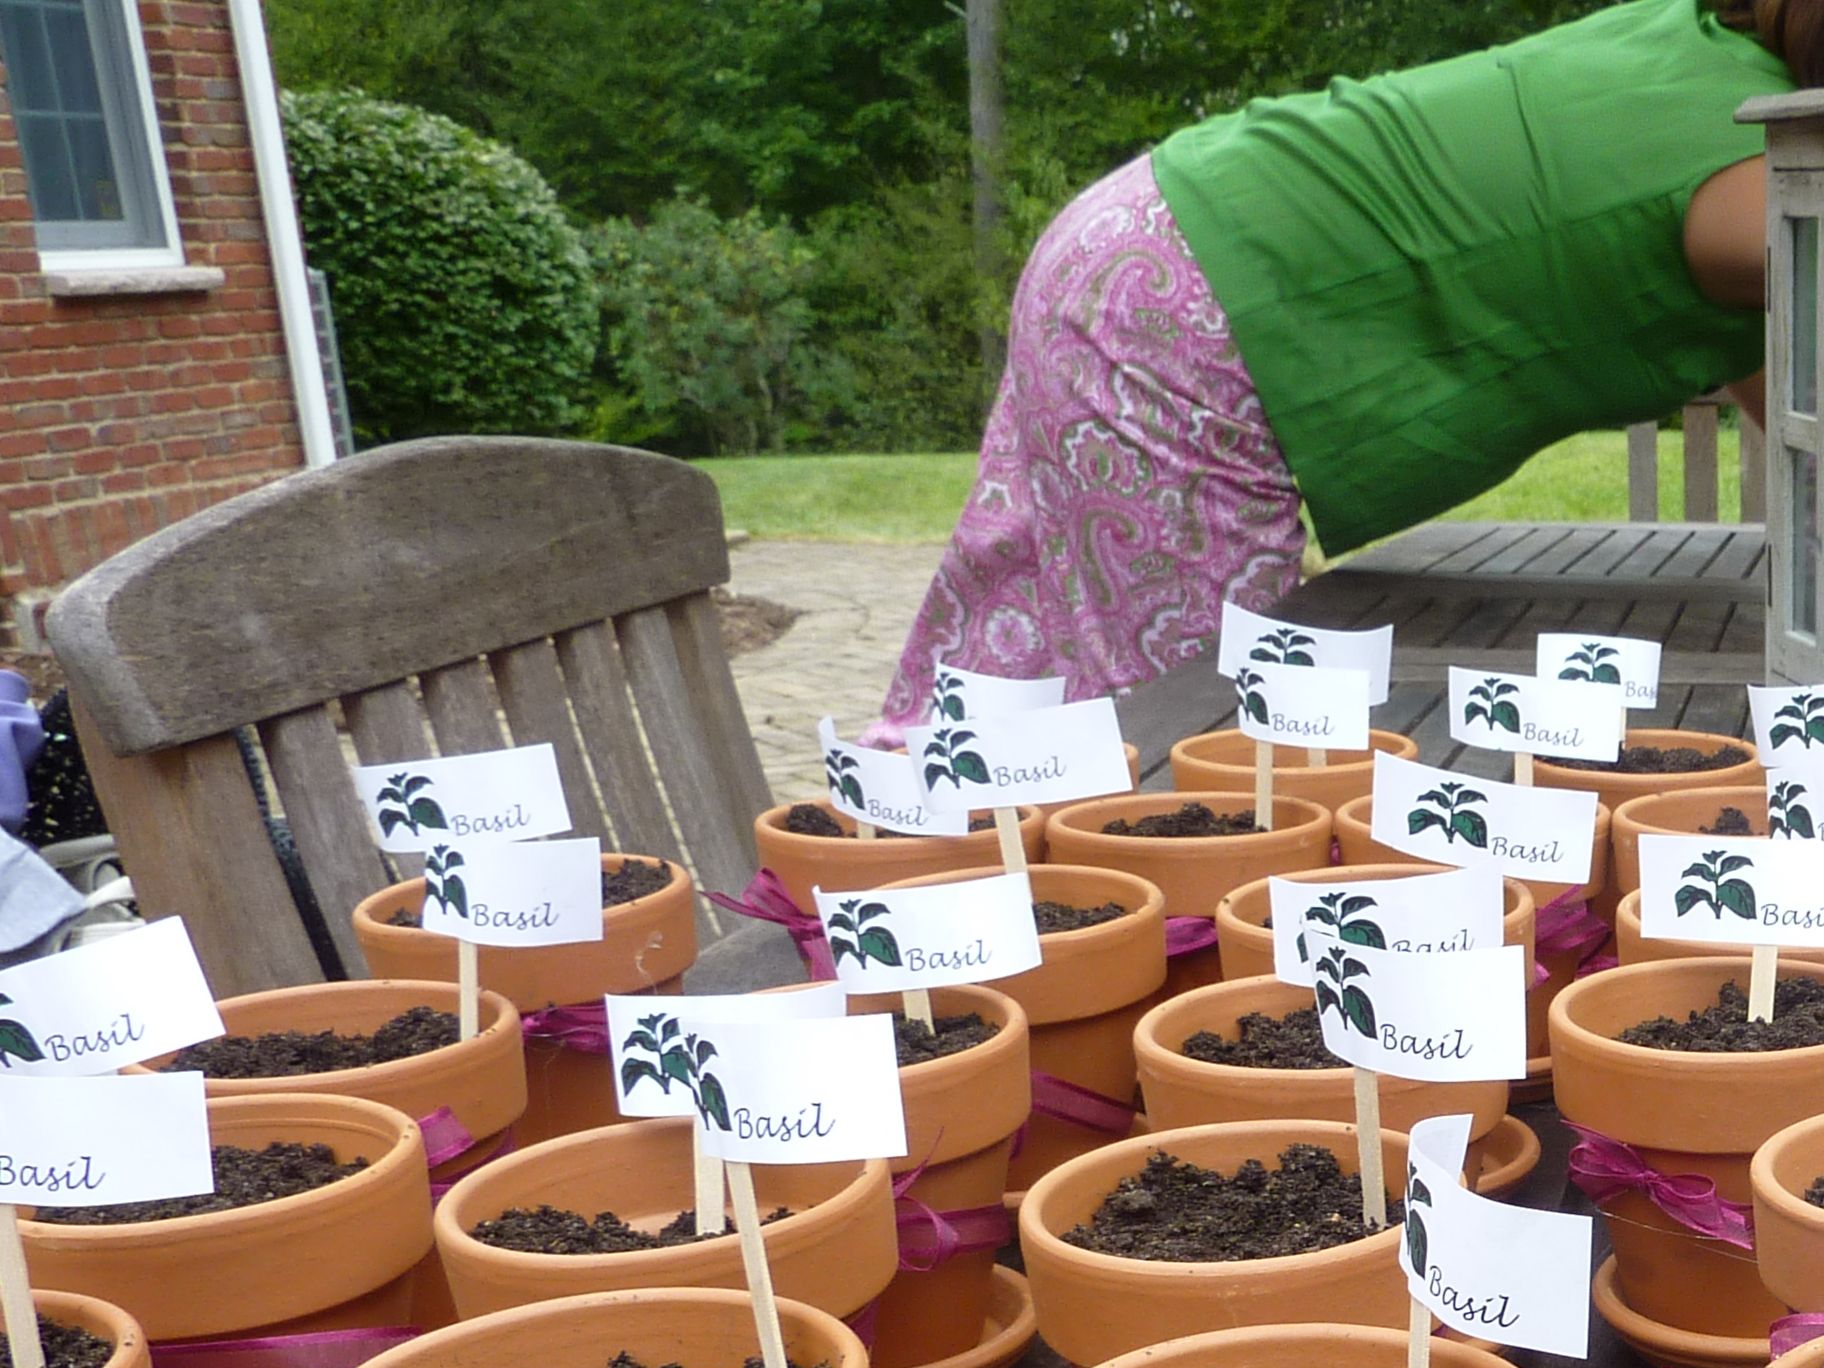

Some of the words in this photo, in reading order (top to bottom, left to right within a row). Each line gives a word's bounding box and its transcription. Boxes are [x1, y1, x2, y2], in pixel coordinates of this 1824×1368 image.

[1271, 713, 1335, 736] Basil
[1523, 723, 1584, 747] Basil
[993, 757, 1066, 787] Basil
[451, 804, 531, 837] Basil
[867, 799, 929, 826] Basil
[1492, 837, 1565, 863] Basil
[471, 902, 560, 929] Basil
[905, 940, 992, 971] Basil
[45, 1014, 145, 1062] Basil
[1380, 1024, 1473, 1059] Basil
[735, 1102, 836, 1141] Basil
[1429, 1266, 1519, 1327] Basil
